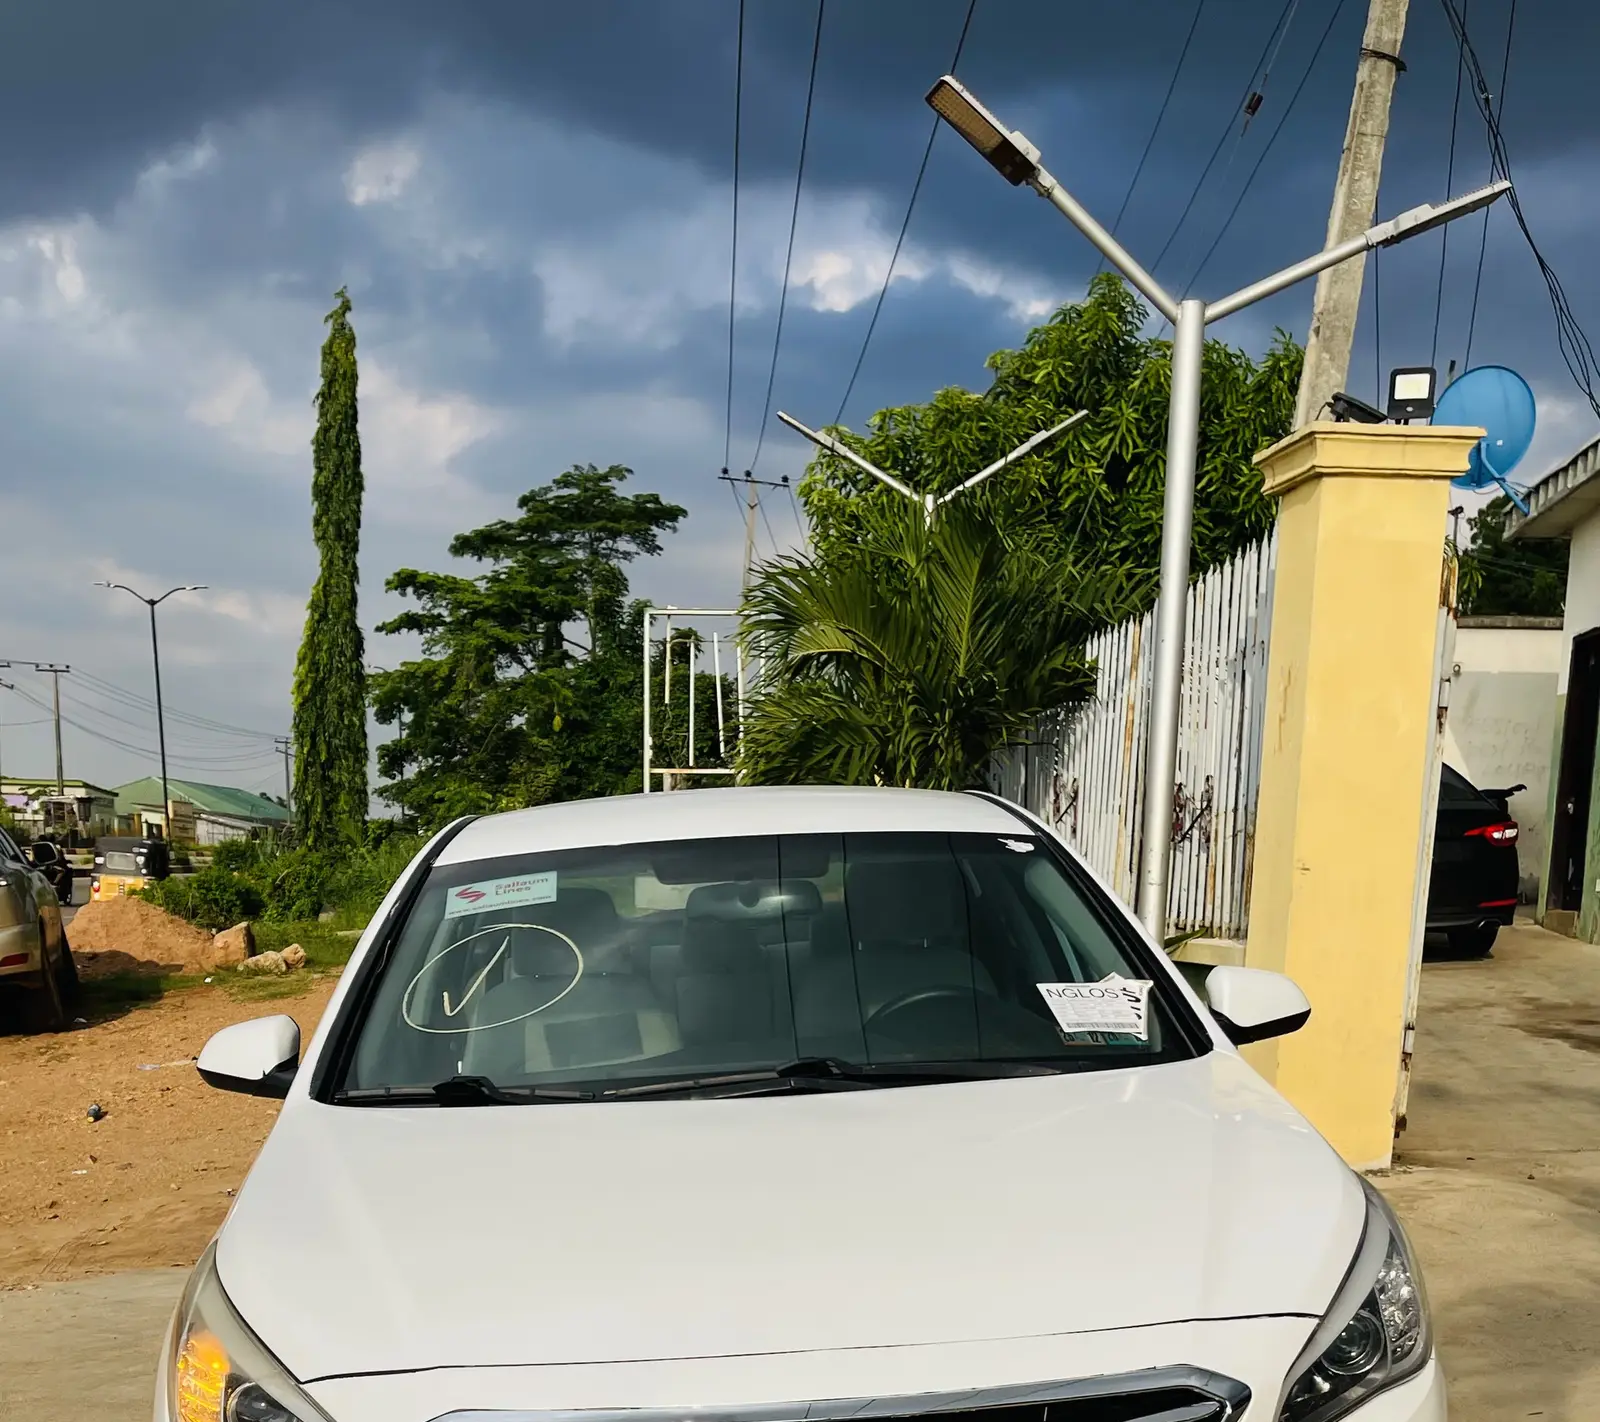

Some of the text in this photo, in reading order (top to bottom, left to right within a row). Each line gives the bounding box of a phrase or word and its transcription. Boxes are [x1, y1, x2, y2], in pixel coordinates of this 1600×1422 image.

[495, 877, 549, 890] Sallaum
[495, 886, 531, 896] Lines
[1046, 988, 1119, 999] NGLOS
